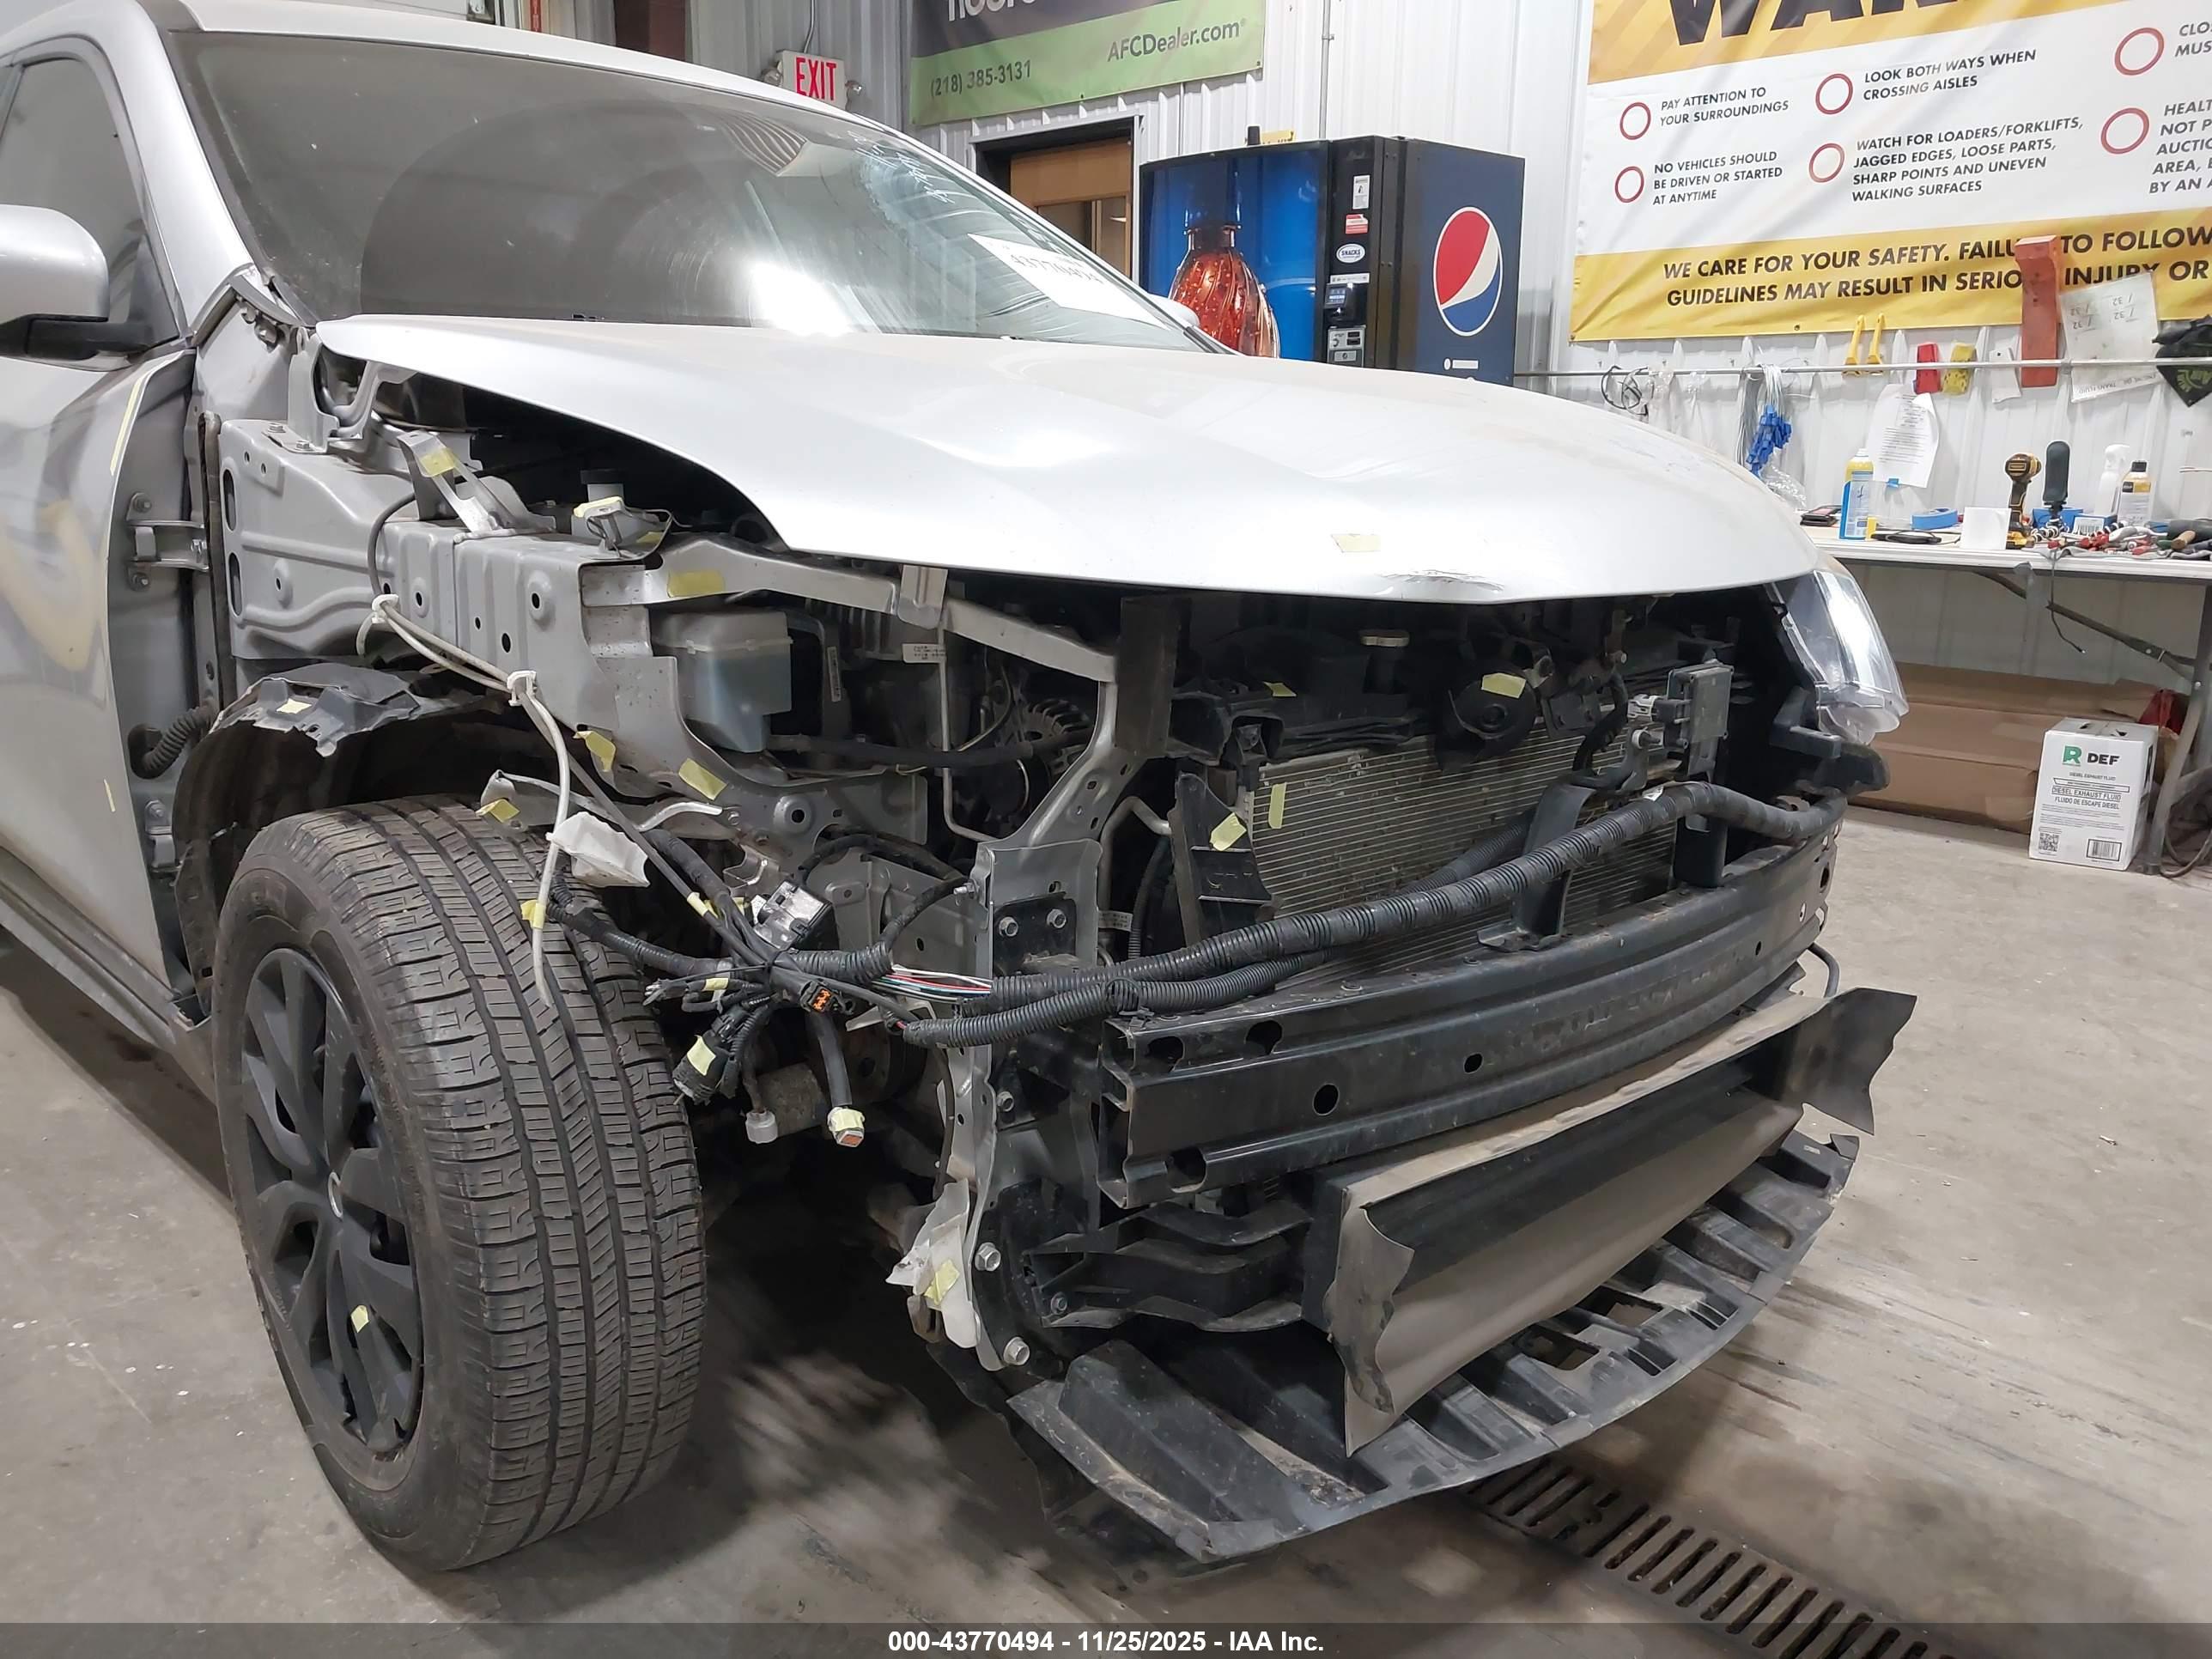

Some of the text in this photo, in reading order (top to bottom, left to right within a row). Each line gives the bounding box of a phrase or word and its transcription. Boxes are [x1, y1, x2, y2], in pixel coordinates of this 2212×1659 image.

[2179, 21, 2212, 36] CLO
[1865, 50, 2037, 82] LOOK BOTH WAYS WHEN
[796, 57, 836, 100] EXIT
[931, 59, 1031, 98] (218) 385-3131
[1863, 76, 1978, 100] CROSSING AISLES
[1662, 87, 1766, 111] PAY ATTENTION TO
[1661, 100, 1789, 126] YOUR SURROUNDINGS
[1856, 117, 2084, 150] WATCH FOR LOADERS/FORKLIFTS,
[2160, 120, 2197, 136] NOT
[1654, 151, 1777, 173] NO VEHICLES SHOULD
[1854, 138, 2056, 167] JAGGED EDGES, LOOSE PARTS,
[1654, 167, 1783, 190] BE DRIVEN OR STARTED
[1853, 156, 2046, 185] SHARP POINTS AND UNEVEN
[2152, 160, 2201, 174] AREA,
[1653, 190, 1717, 205] AT ANYTIME
[1852, 180, 1982, 202] WALKING SURFACES
[2149, 178, 2202, 194] BY AN
[1663, 227, 2212, 279] WE CARE FOR YOUR SAFETY. FAILU TO FOLLOW
[1668, 284, 1778, 306] GUIDELINES
[1784, 282, 1831, 300] MAY
[1837, 276, 1913, 297] RESULT
[1921, 274, 1946, 292] IN
[1956, 270, 2022, 290] SERIO
[2169, 260, 2209, 281] OR
[2087, 753, 2120, 765] DEF
[2052, 787, 2073, 795] DIESEL
